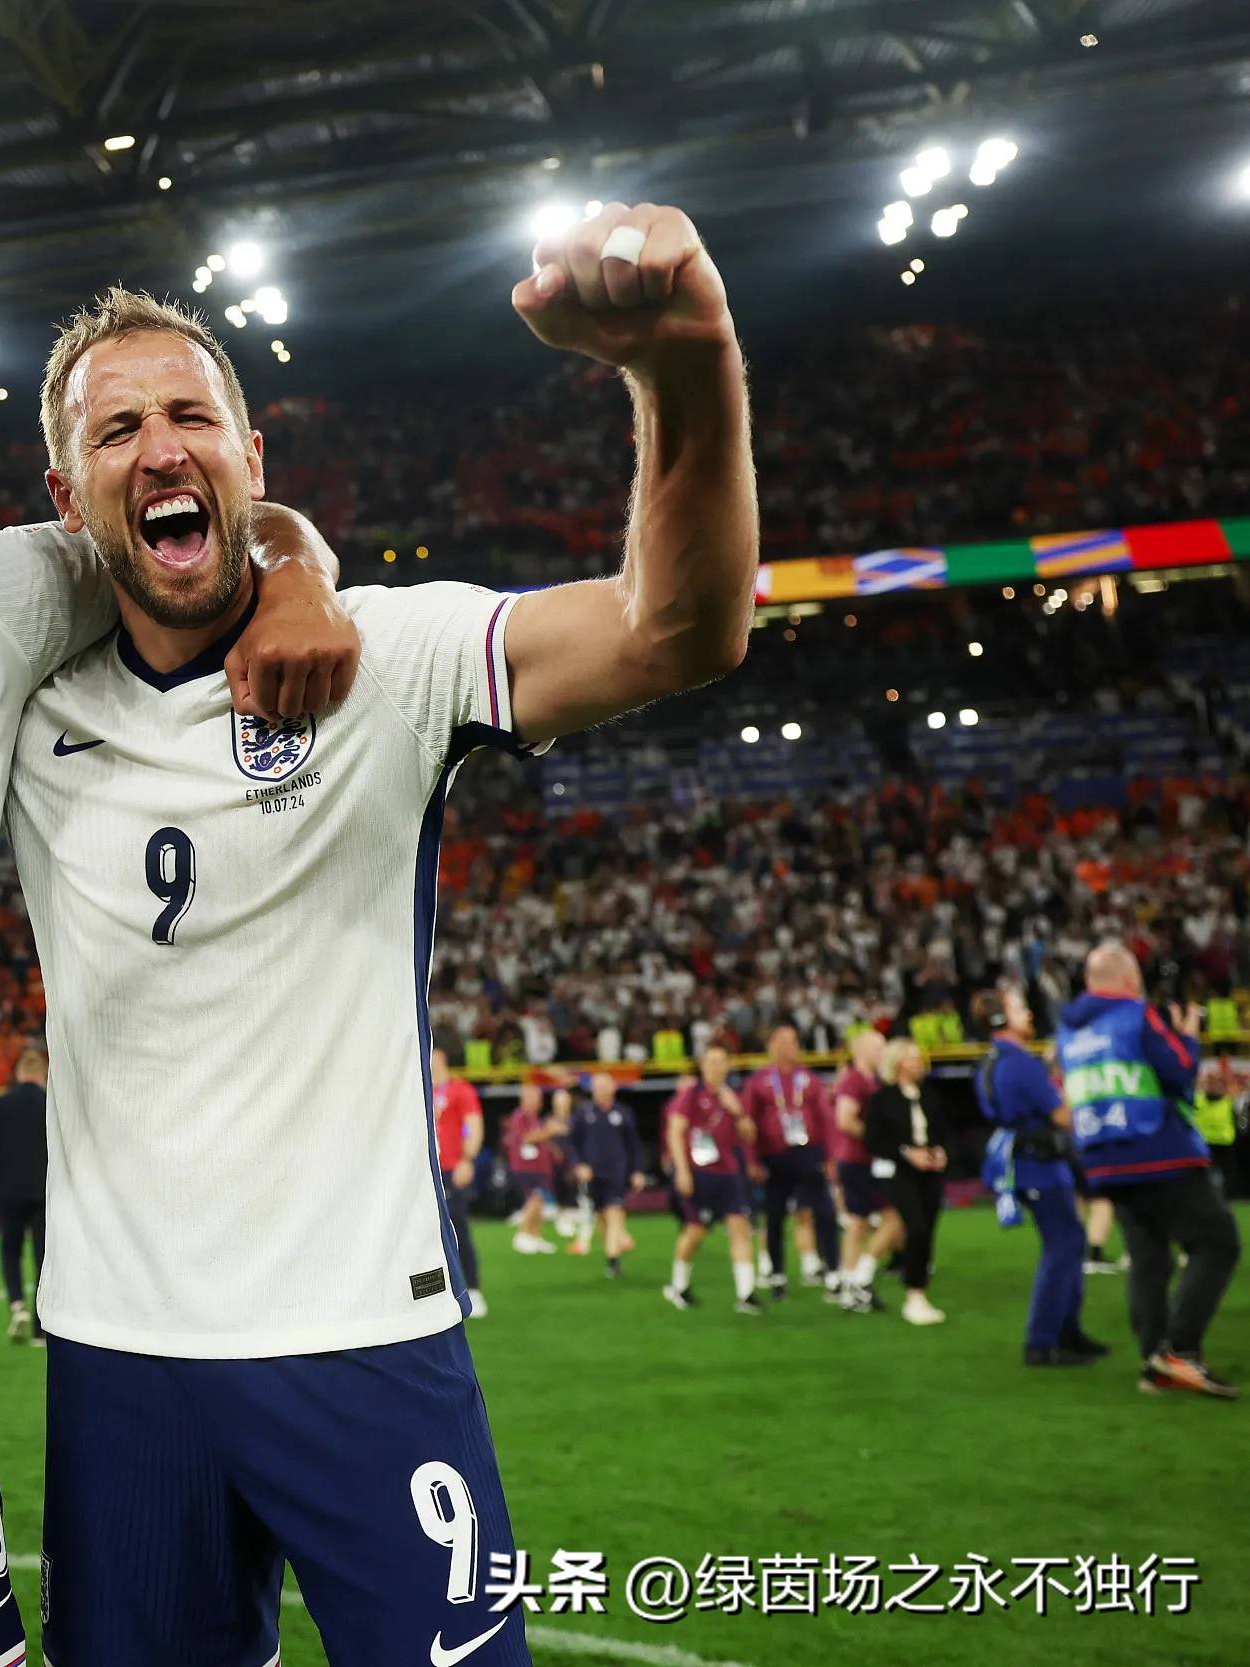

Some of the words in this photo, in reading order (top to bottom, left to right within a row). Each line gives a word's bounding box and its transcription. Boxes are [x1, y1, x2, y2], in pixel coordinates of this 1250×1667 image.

[245, 772, 322, 800] ETHERLANDS
[259, 795, 305, 815] 10.07.24
[145, 826, 196, 945] 9
[410, 1461, 478, 1605] 9
